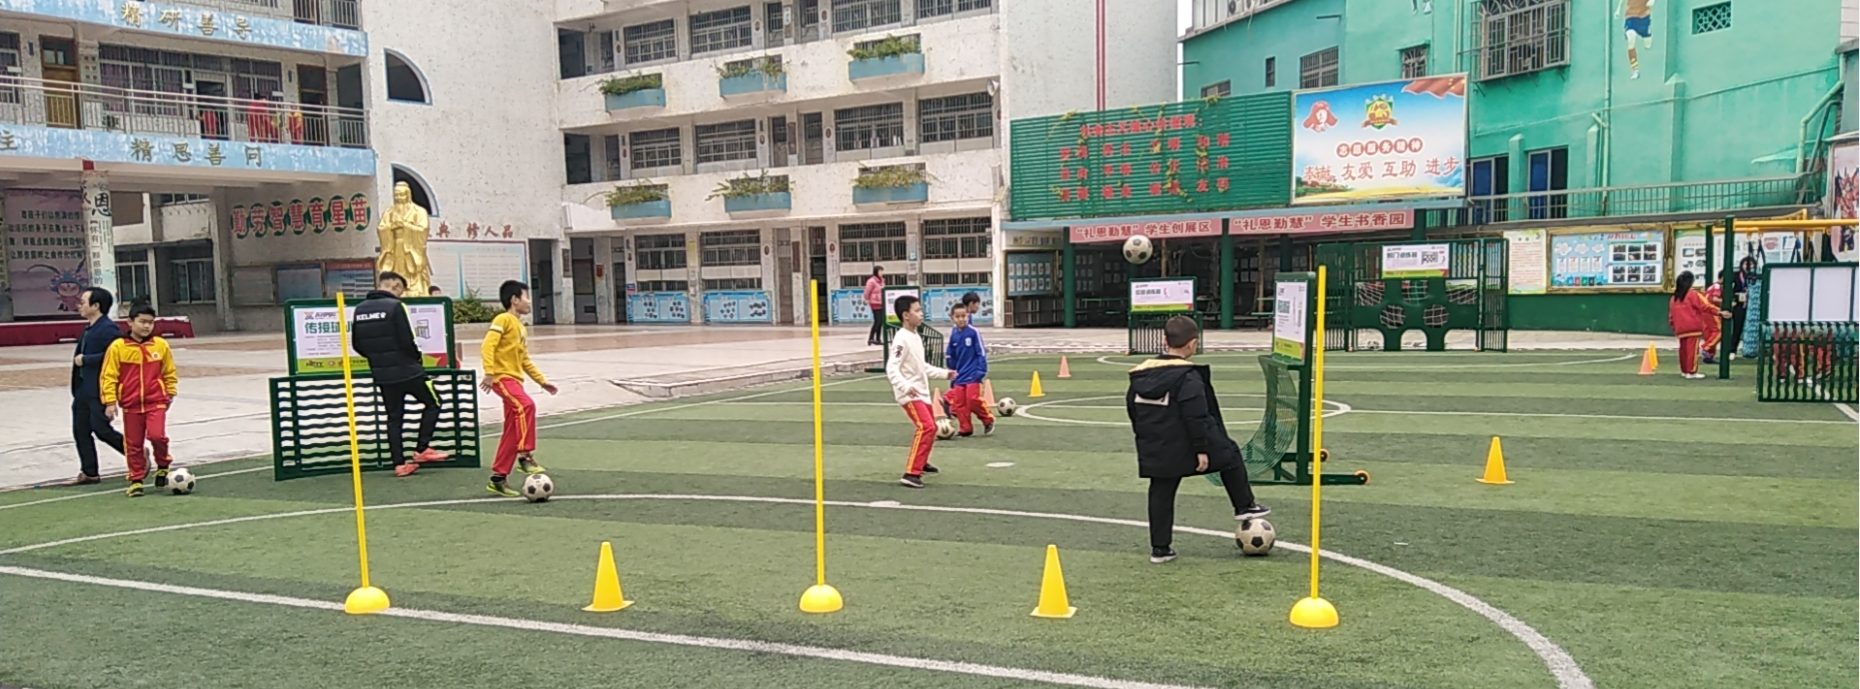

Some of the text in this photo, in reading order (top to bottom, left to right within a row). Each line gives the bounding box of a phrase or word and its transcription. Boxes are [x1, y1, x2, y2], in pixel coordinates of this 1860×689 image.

[121, 2, 252, 39] 精研善导
[1341, 161, 1373, 180] 友爱
[1382, 159, 1417, 178] 互助
[1424, 156, 1459, 176] 进步
[232, 197, 369, 235] 勤劳智慧育星苗
[1322, 212, 1405, 228] 学生书香园
[1146, 221, 1211, 235] 学生创展区
[356, 312, 380, 321] KELME
